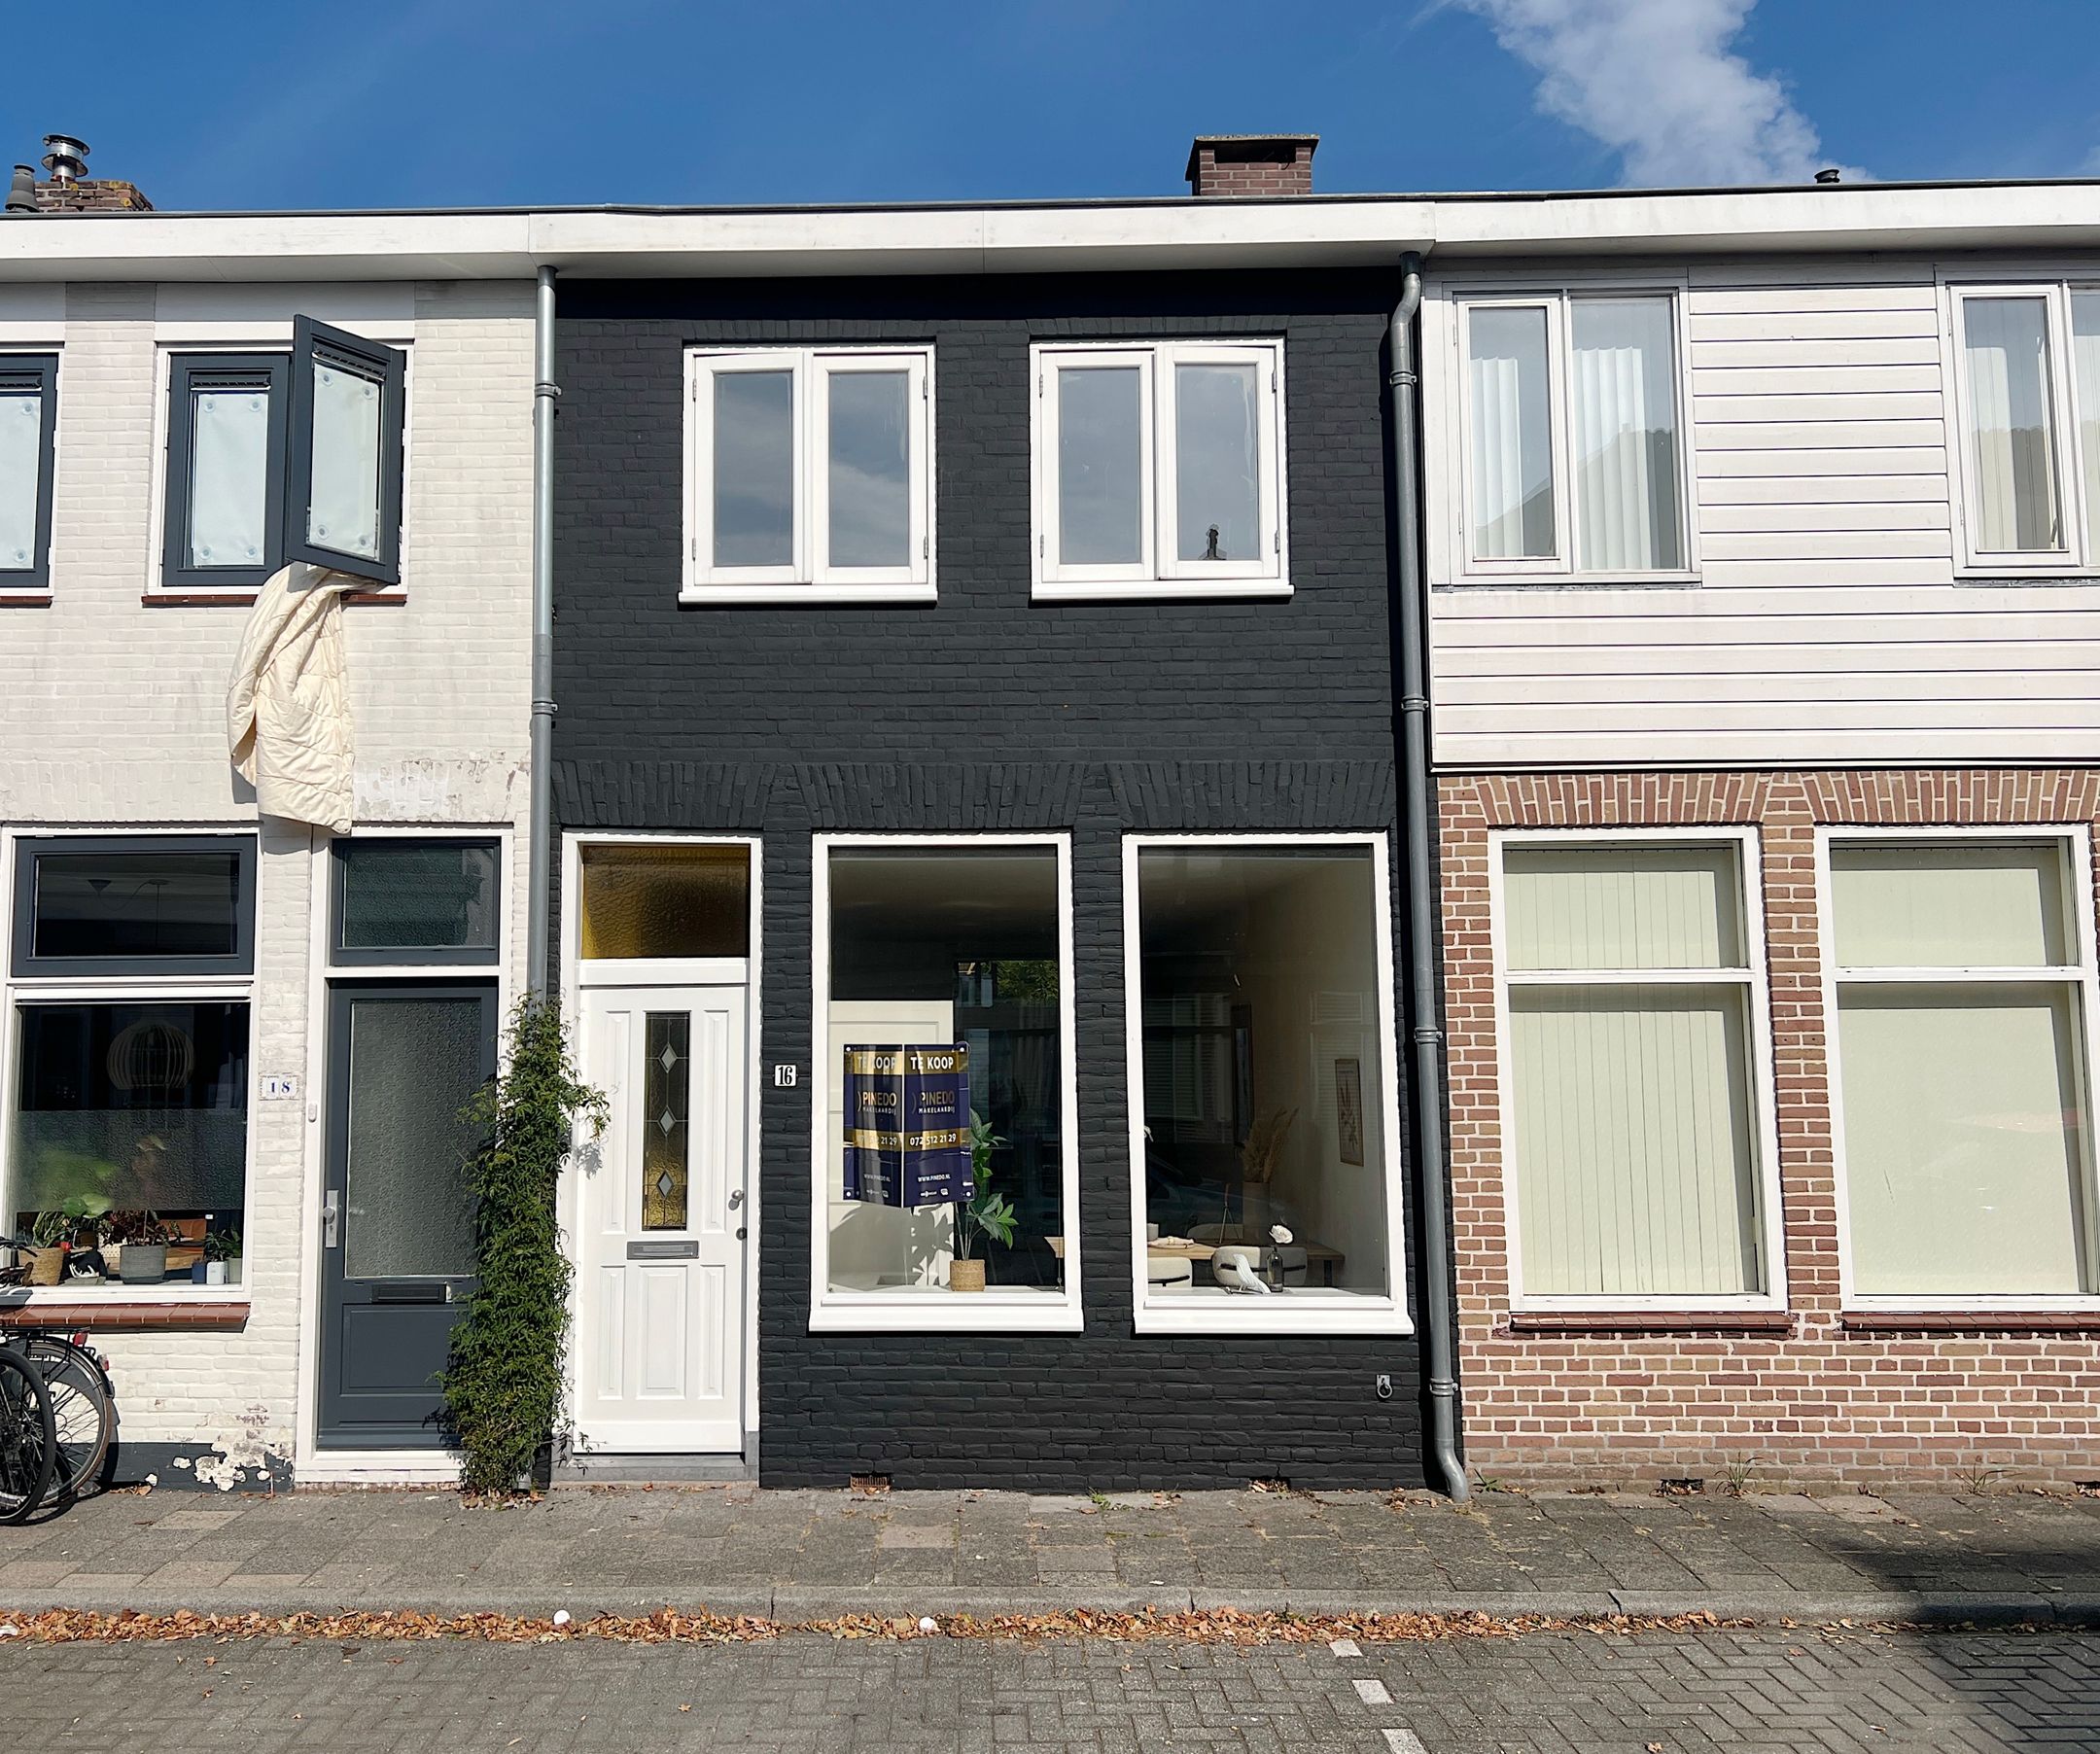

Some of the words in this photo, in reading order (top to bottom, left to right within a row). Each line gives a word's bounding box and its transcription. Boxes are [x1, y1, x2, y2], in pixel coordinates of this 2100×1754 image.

[910, 1056, 924, 1070] TE
[927, 1056, 954, 1070] KOOP
[778, 1066, 792, 1085] 16
[271, 1081, 290, 1094] 18
[862, 1091, 896, 1106] PINEDO
[919, 1090, 955, 1105] PINEDO
[881, 1136, 888, 1144] 21
[889, 1137, 897, 1146] 29
[909, 1136, 923, 1146] 072
[926, 1135, 938, 1144] 512
[939, 1135, 947, 1143] 21
[948, 1133, 957, 1142] 29
